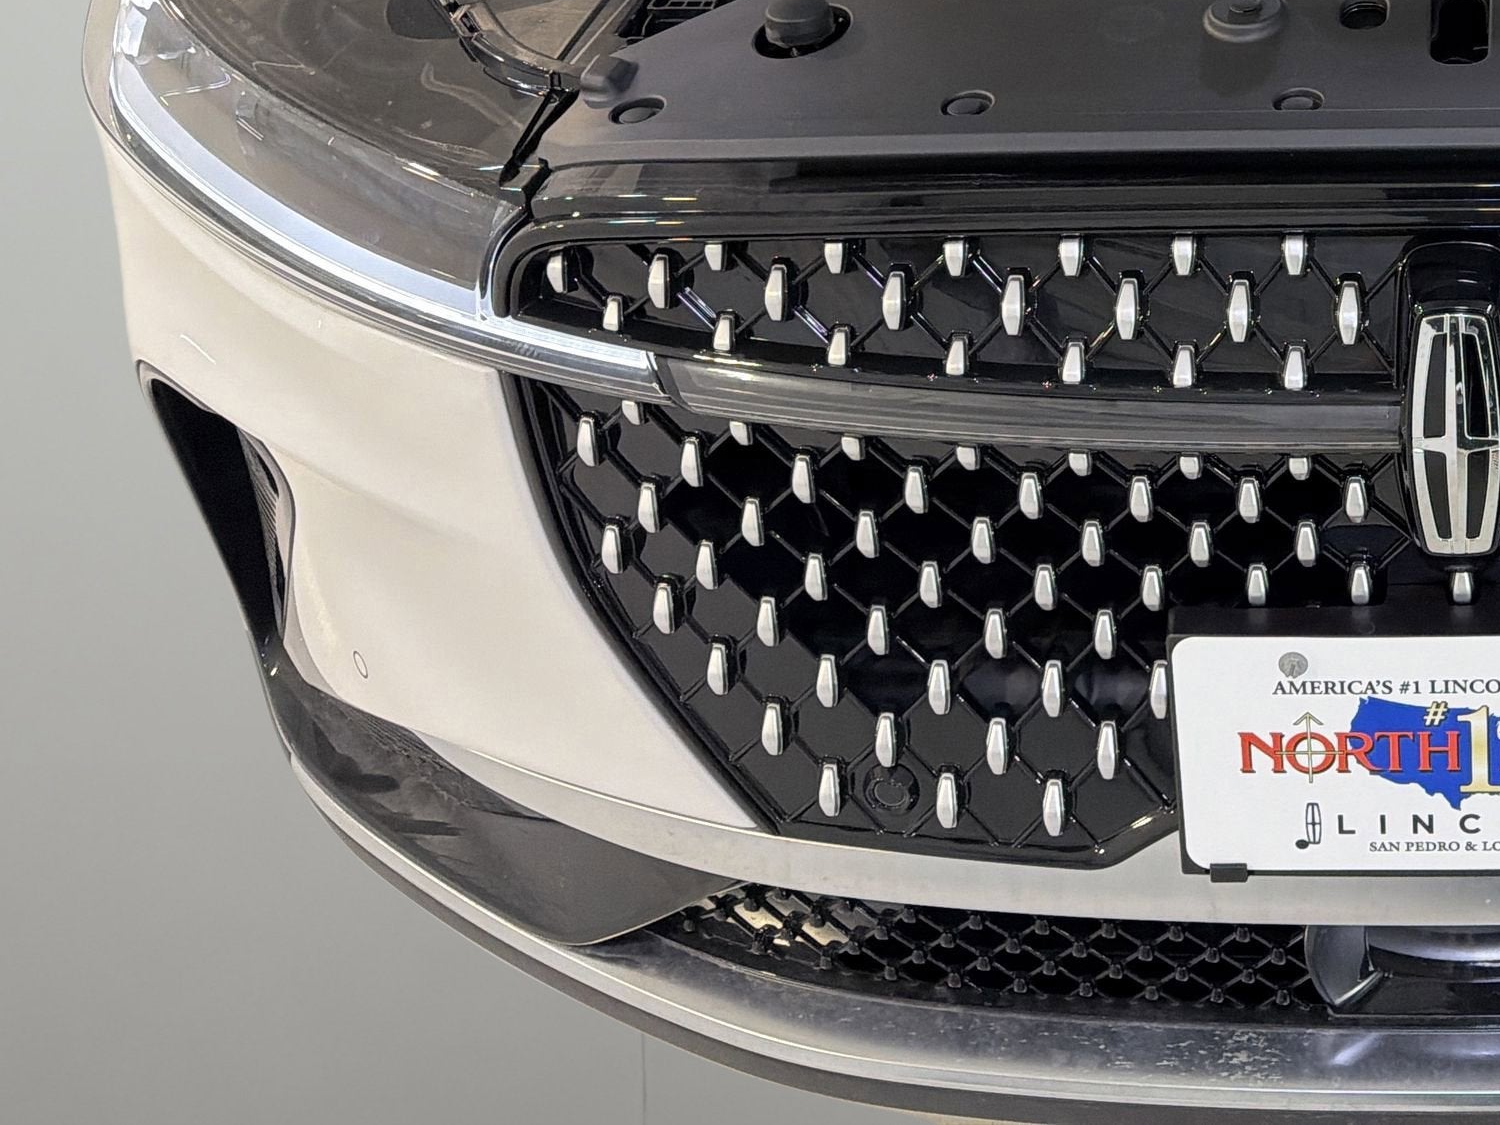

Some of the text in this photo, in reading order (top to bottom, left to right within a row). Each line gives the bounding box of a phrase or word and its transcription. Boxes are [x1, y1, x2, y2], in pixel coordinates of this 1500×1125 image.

[1272, 679, 1394, 696] AMERICA'S
[1399, 680, 1421, 695] #1
[1237, 730, 1463, 774] NORTH
[1369, 840, 1401, 853] SAN
[1404, 840, 1461, 853] PEDRO
[1464, 840, 1478, 853] &
